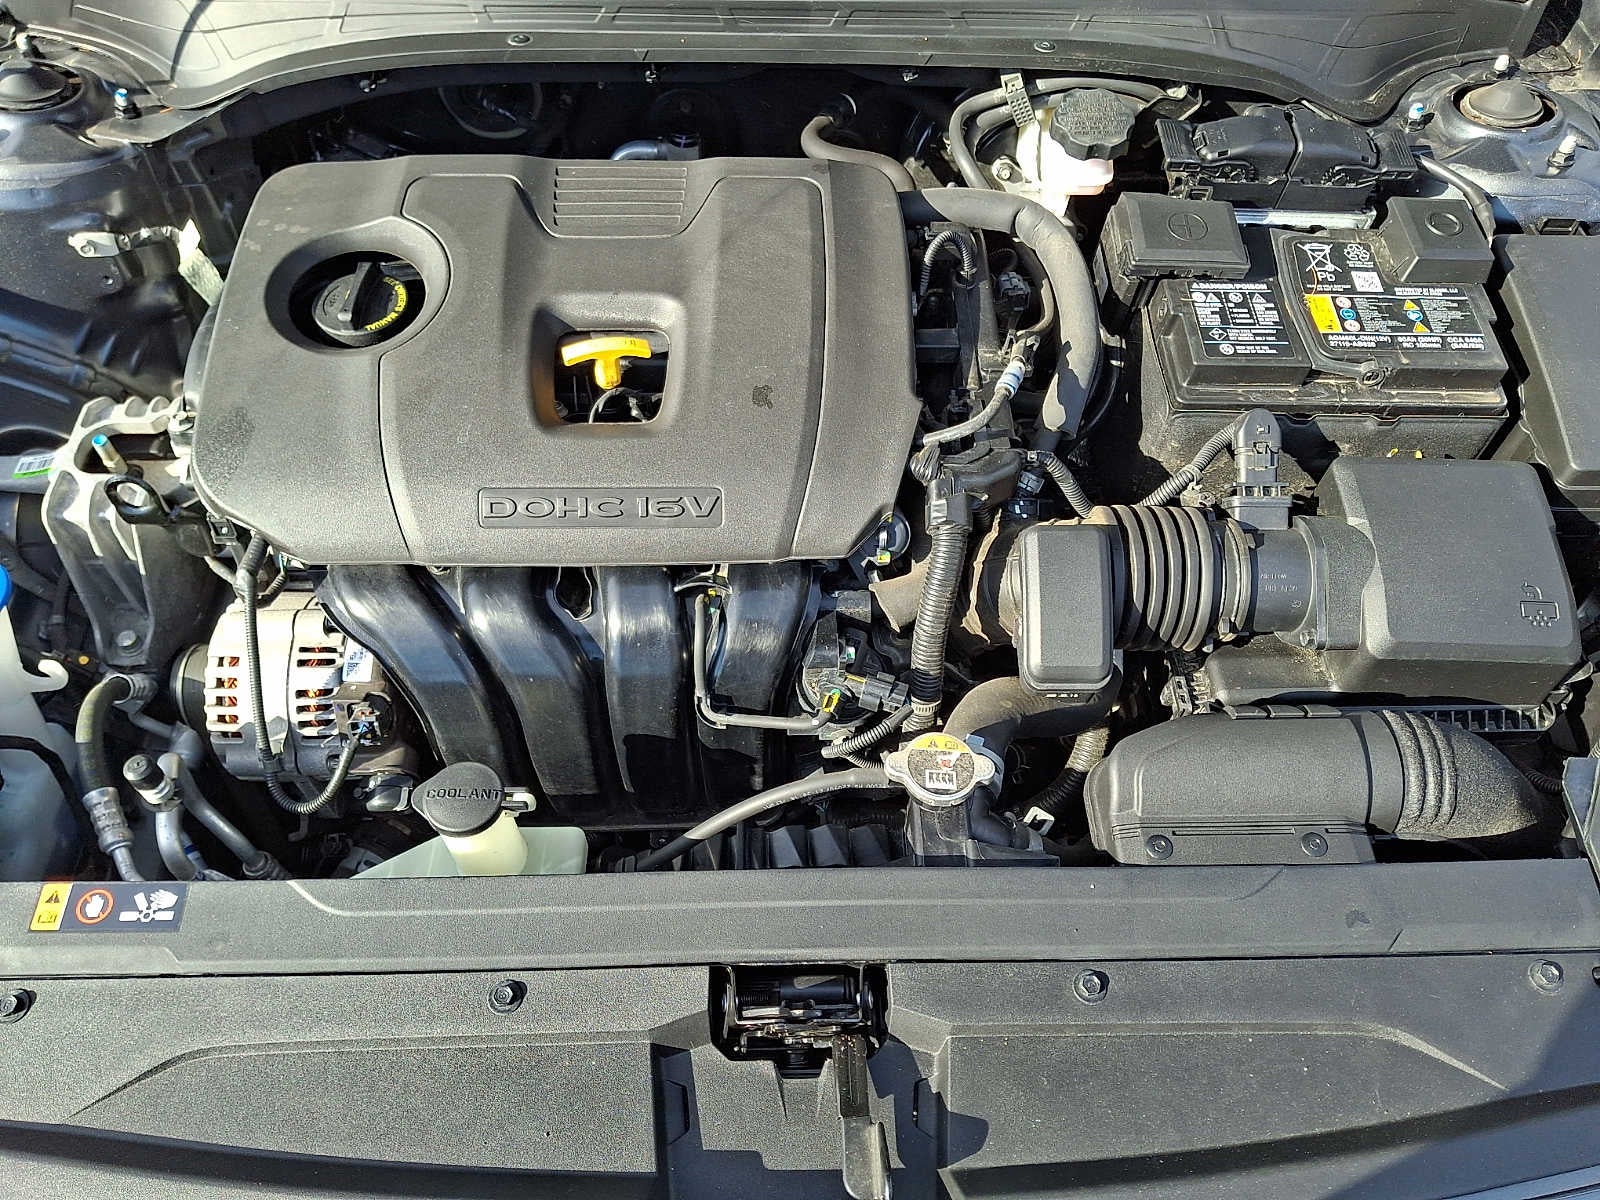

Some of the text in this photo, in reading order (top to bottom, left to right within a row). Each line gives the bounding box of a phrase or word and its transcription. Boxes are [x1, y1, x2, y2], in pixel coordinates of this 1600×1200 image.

[1317, 272, 1335, 282] Pb
[365, 312, 399, 331] MANUAL
[482, 495, 720, 519] DOHC 16V
[426, 788, 503, 801] COOLANT
